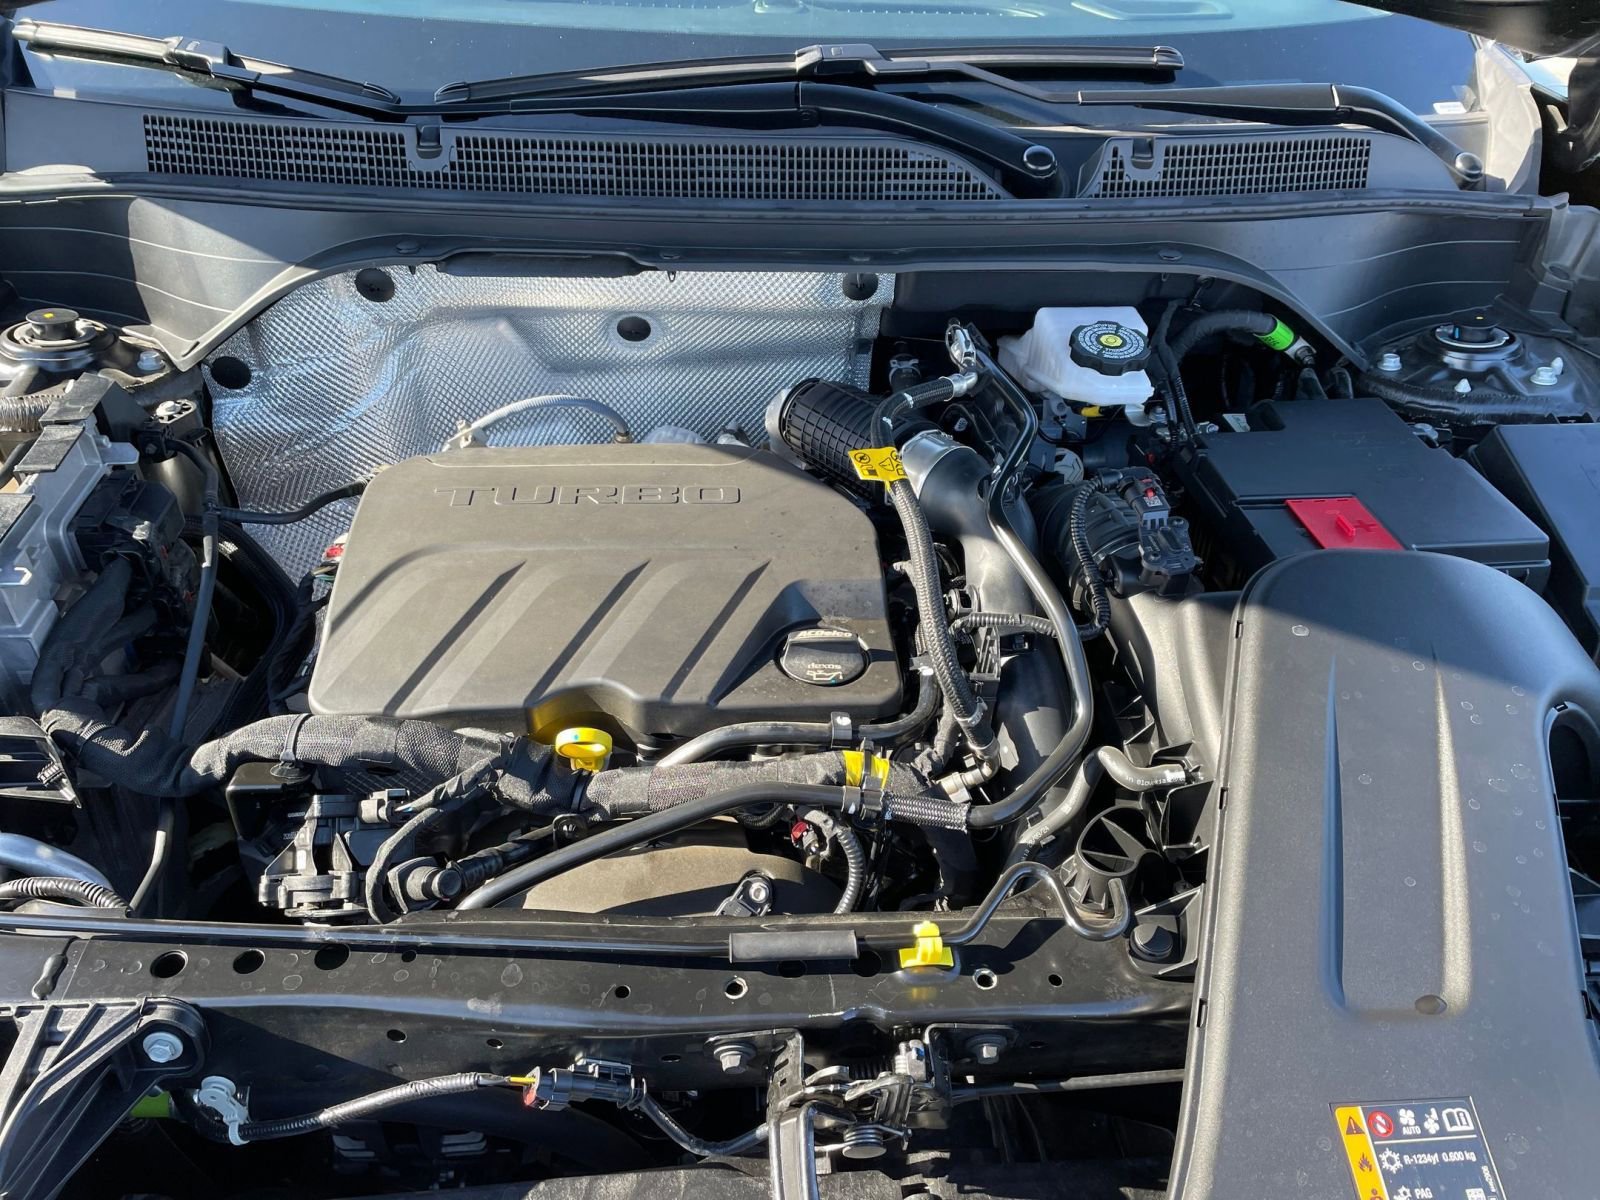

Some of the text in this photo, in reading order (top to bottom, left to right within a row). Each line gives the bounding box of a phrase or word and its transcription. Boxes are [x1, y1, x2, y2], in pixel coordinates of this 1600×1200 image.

[434, 486, 741, 506] TURBO
[796, 630, 853, 639] ACDelco
[807, 662, 842, 670] dexos
[1402, 1125, 1422, 1135] AUTO
[1464, 1150, 1477, 1162] kg
[1414, 1187, 1433, 1199] PAG
